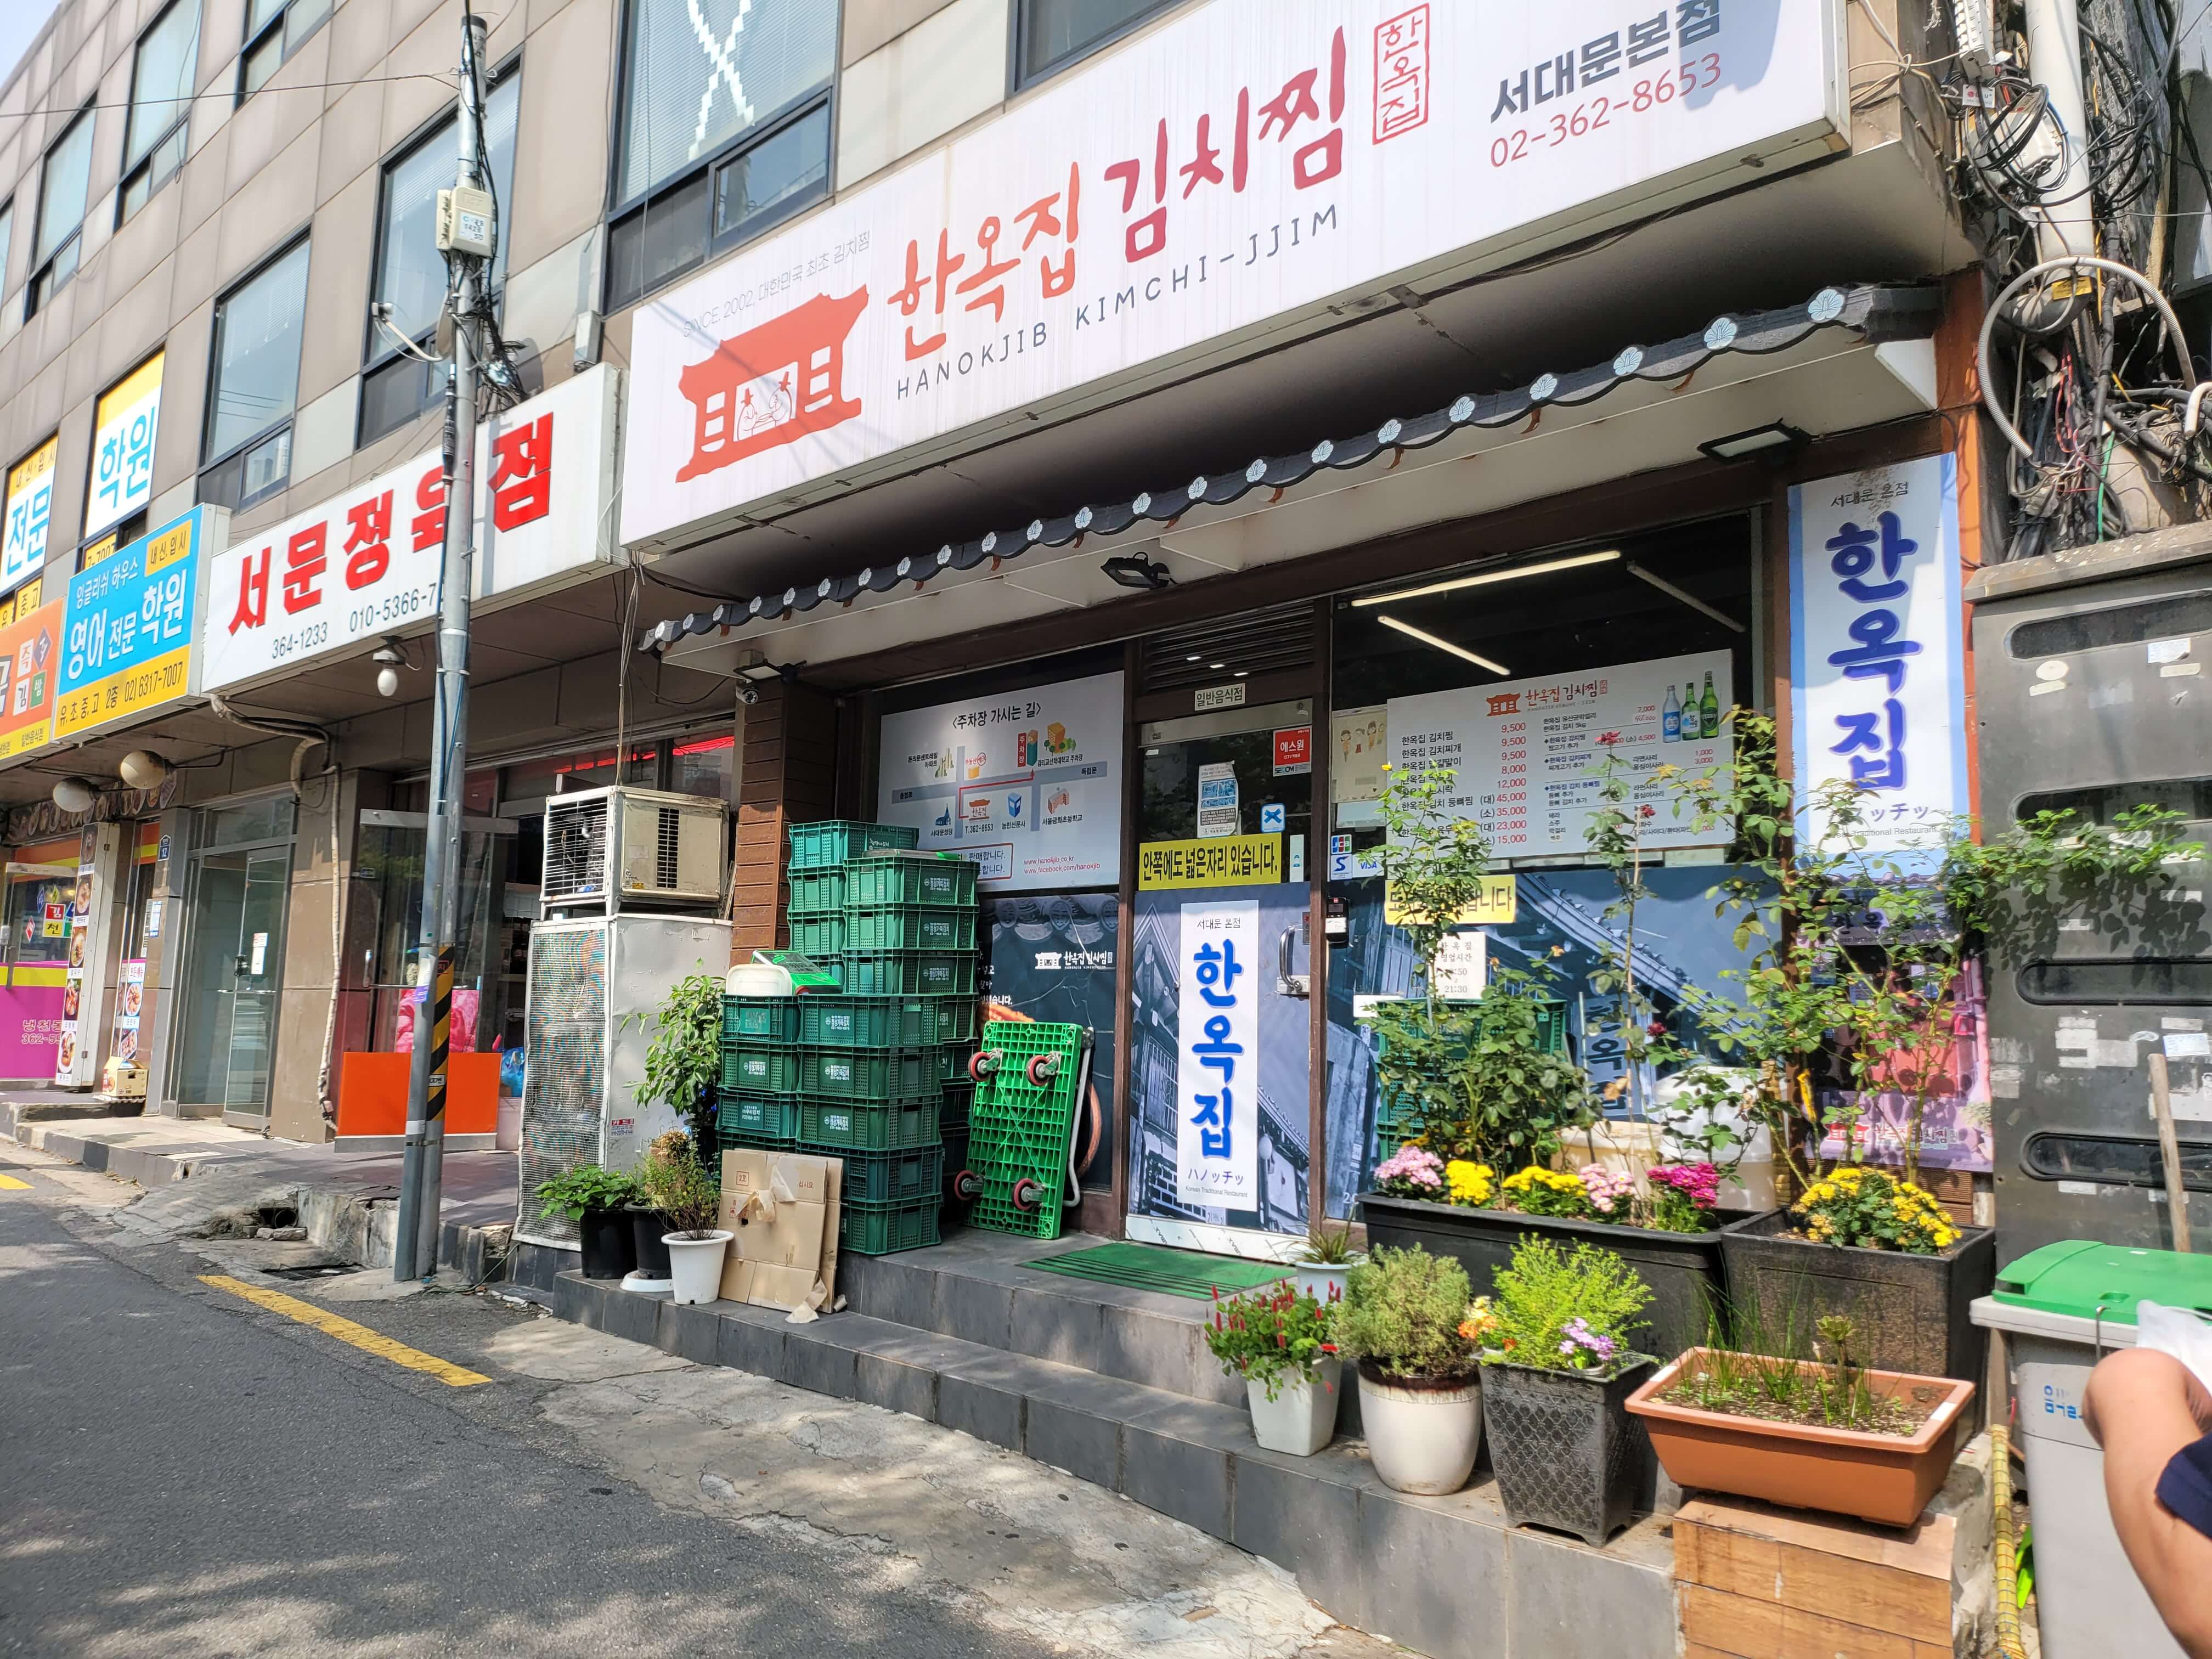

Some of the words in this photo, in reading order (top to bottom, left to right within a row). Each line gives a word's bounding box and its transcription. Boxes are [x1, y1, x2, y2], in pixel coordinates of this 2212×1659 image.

[1491, 0, 1720, 124] 서대문본점
[1491, 53, 1722, 168] 02-362-8653
[887, 162, 1080, 362] 한옥집
[1104, 25, 1346, 263] 김치찜
[759, 264, 803, 300] 대한민국
[806, 252, 829, 277] 최초
[834, 230, 870, 264] 김치찜
[896, 321, 1047, 400] HANOKJIB
[1075, 204, 1338, 330] KIMCHI-JJIM
[7, 484, 52, 575] 전문
[98, 407, 156, 509] 학원
[1830, 487, 1874, 509] 서대문
[1882, 480, 1909, 501] 본점
[76, 575, 108, 610] 잉글리쉬
[111, 559, 138, 589] 하우스
[68, 608, 108, 680] 영어
[108, 611, 137, 661] 전문
[142, 569, 187, 645] 학원
[272, 622, 328, 659] 364-1233
[350, 582, 443, 633] 010-5366-7
[1825, 509, 1923, 794] 한옥집
[105, 686, 119, 710] 2층
[1196, 687, 1244, 707] 일반음식점
[1525, 686, 1559, 707] 한옥집
[1562, 680, 1597, 701] 김치찜
[991, 706, 1022, 724] 가시는
[22, 727, 44, 747] 일반음식점
[1402, 734, 1425, 746] 한옥집
[1429, 731, 1453, 742] 김치찜
[1502, 723, 1526, 733] 9,500
[1280, 739, 1304, 753] 에스원
[1402, 747, 1425, 758] 한옥집
[1429, 743, 1461, 755] 김치찌개
[1502, 736, 1526, 747] 9,500
[1070, 754, 1083, 763] 주차장
[1402, 760, 1425, 771] 한옥집
[1502, 750, 1526, 761] 9,500
[1633, 754, 1657, 762] 라면사리
[1081, 767, 1098, 776] 독립문
[1502, 764, 1526, 775] 8,000
[1497, 778, 1526, 788] 12,000
[1448, 796, 1473, 807] 등뼈찜
[1480, 794, 1495, 805] (대)
[1497, 792, 1526, 803] 45,000
[972, 807, 987, 817] 한옥집
[1042, 814, 1083, 825] 서울금화초등학교
[1480, 808, 1495, 819] (소)
[1497, 806, 1526, 816] 35,000
[930, 828, 953, 837] 서대문성당
[965, 823, 994, 834] T.362-8653
[1001, 820, 1026, 830] 농민신문사
[1480, 822, 1495, 833] (대)
[1497, 820, 1526, 831] 23,000
[1481, 836, 1495, 847] 소)
[1497, 834, 1526, 845] 15,000
[969, 850, 1006, 862] 판매합니다.
[1024, 856, 1075, 865] www.hanokjib.co.kr
[1143, 848, 1183, 882] 안쪽에도
[1186, 845, 1227, 879] 넓은자리
[1231, 842, 1278, 876] 있습니다.
[1024, 862, 1101, 874] www.facebook.com/hanokjib
[1197, 918, 1221, 929] 서대문
[1224, 917, 1241, 928] 본점
[1064, 951, 1084, 966] 한옥집
[1441, 952, 1472, 963] 영업시간
[1190, 939, 1244, 1159] 한옥집
[1201, 1187, 1223, 1195] Traditional
[1224, 1189, 1248, 1198] Restaurant
